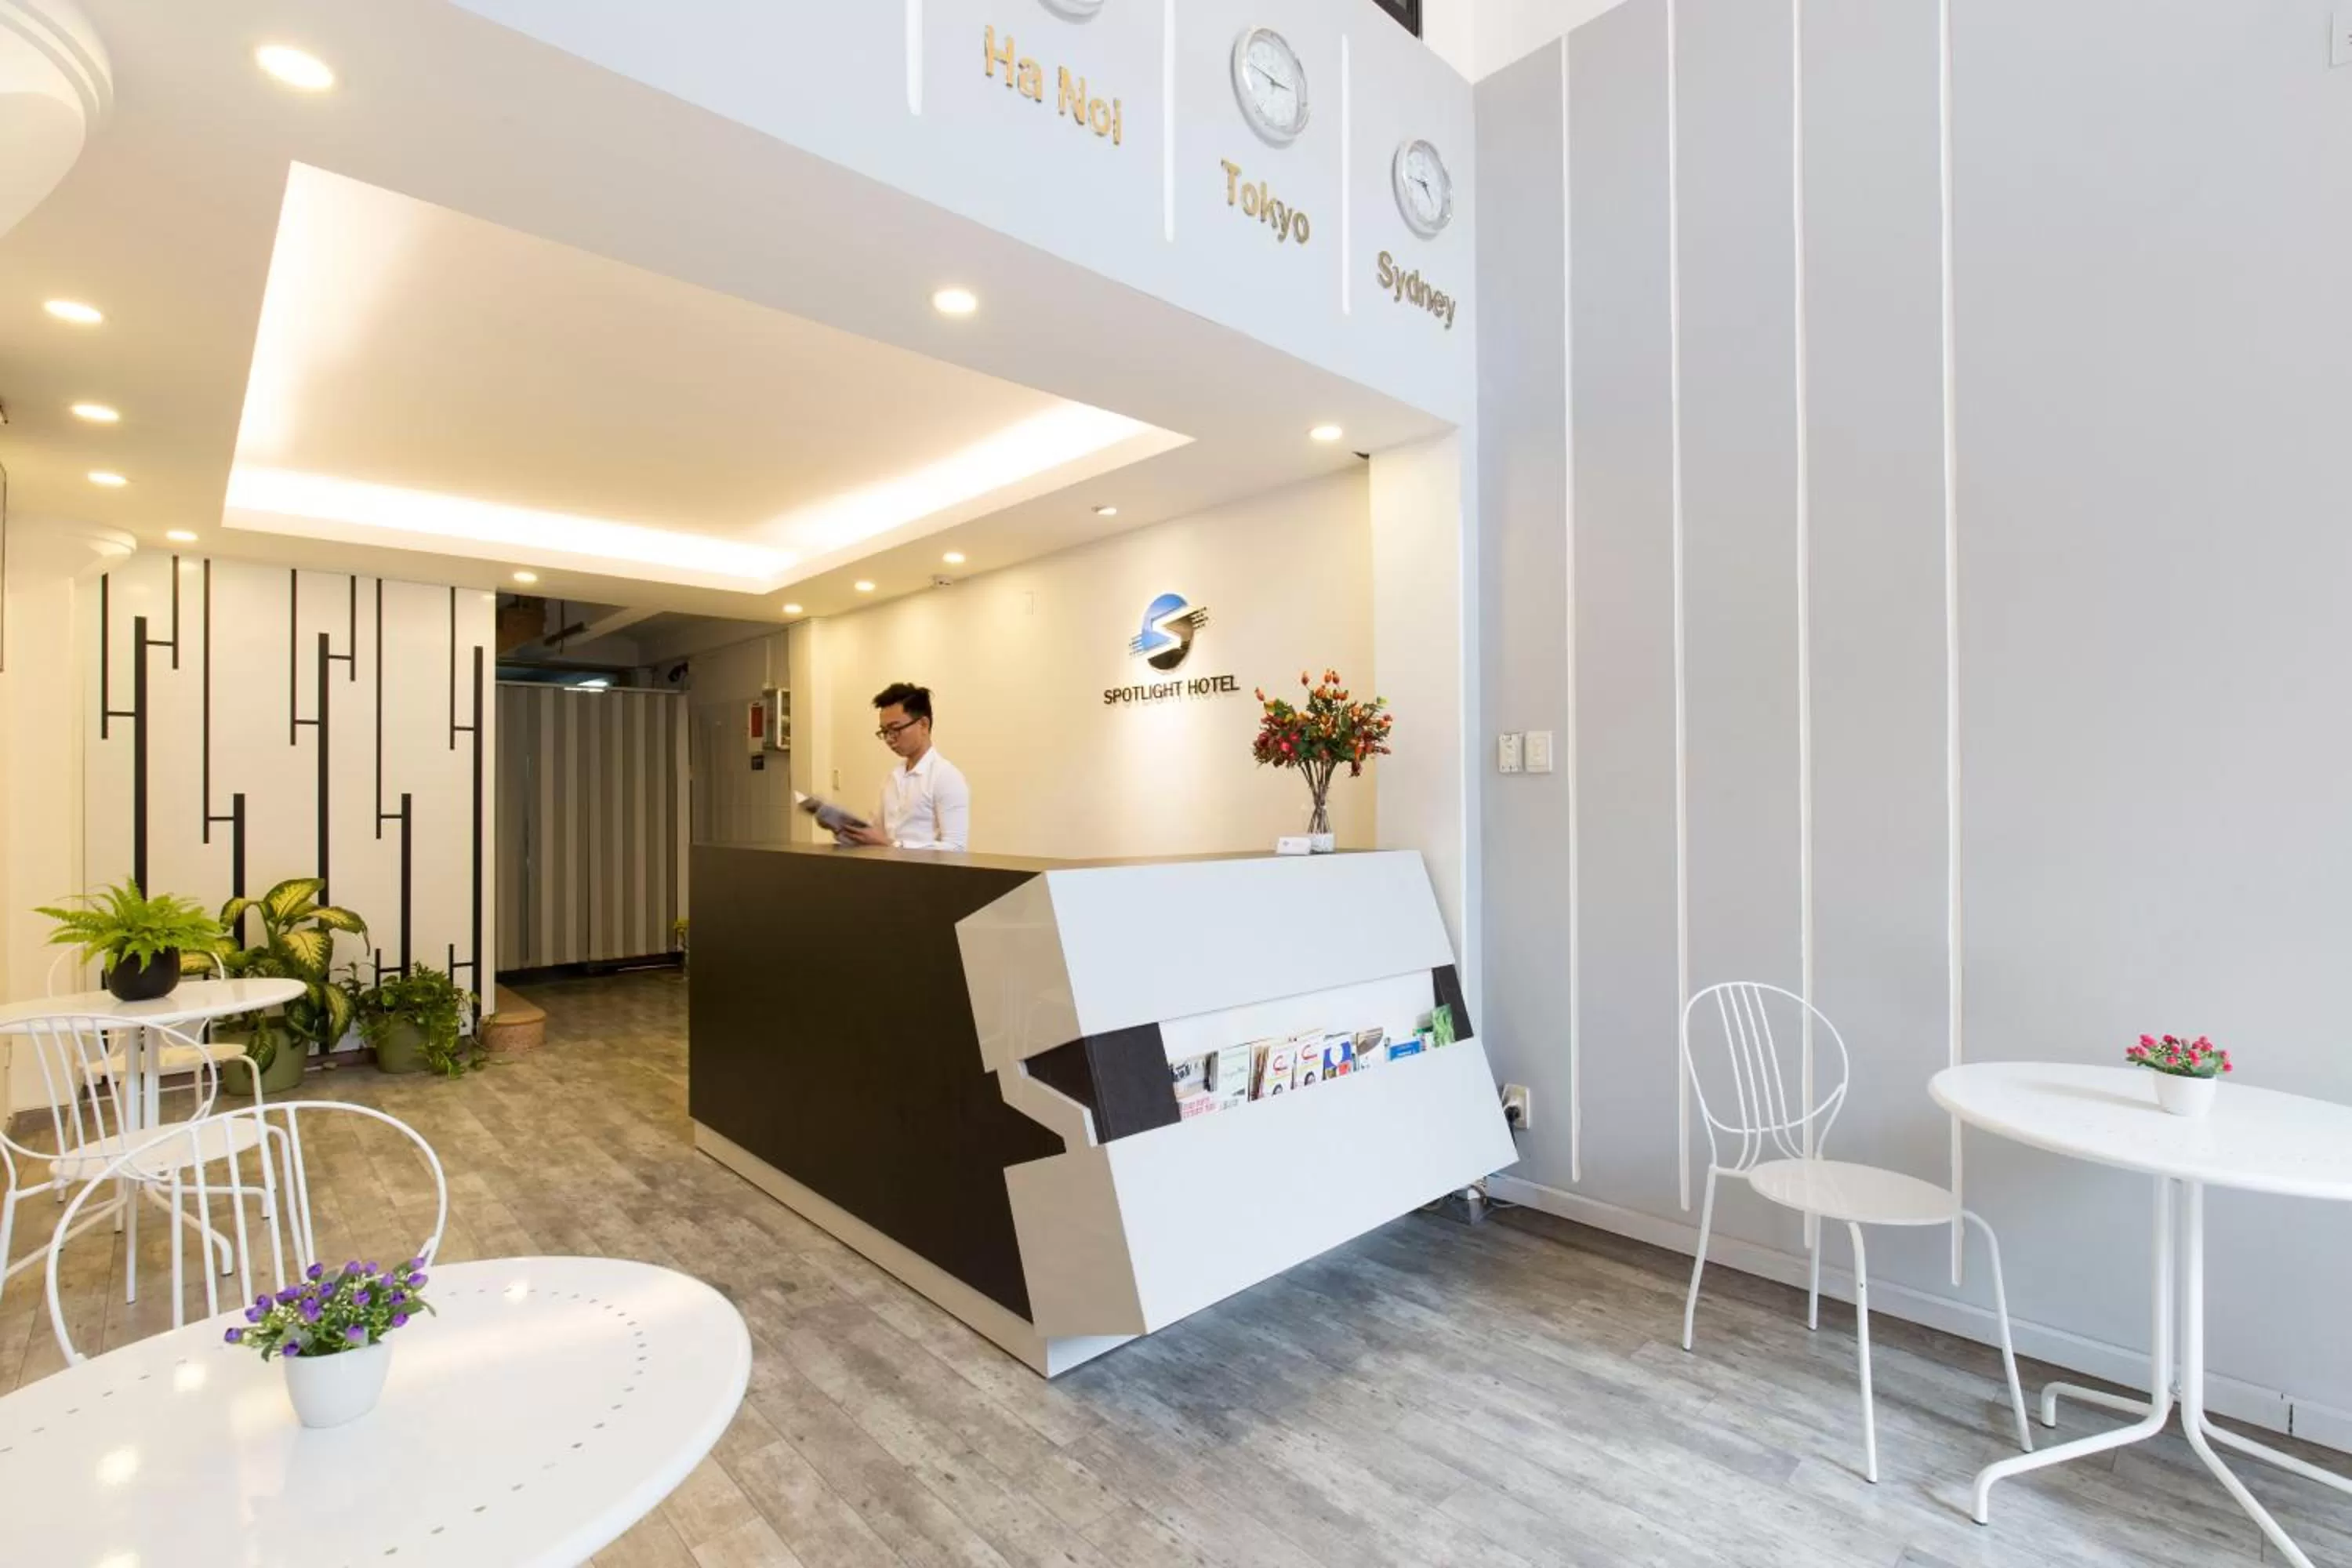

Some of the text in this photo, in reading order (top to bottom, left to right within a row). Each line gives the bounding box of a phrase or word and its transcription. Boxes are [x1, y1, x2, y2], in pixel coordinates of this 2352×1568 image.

[984, 24, 1122, 146] Ha Noi
[1220, 158, 1310, 245] Tokyo
[1376, 250, 1456, 330] Sydney
[1103, 674, 1240, 705] SPOTLIGHT HOTEL
